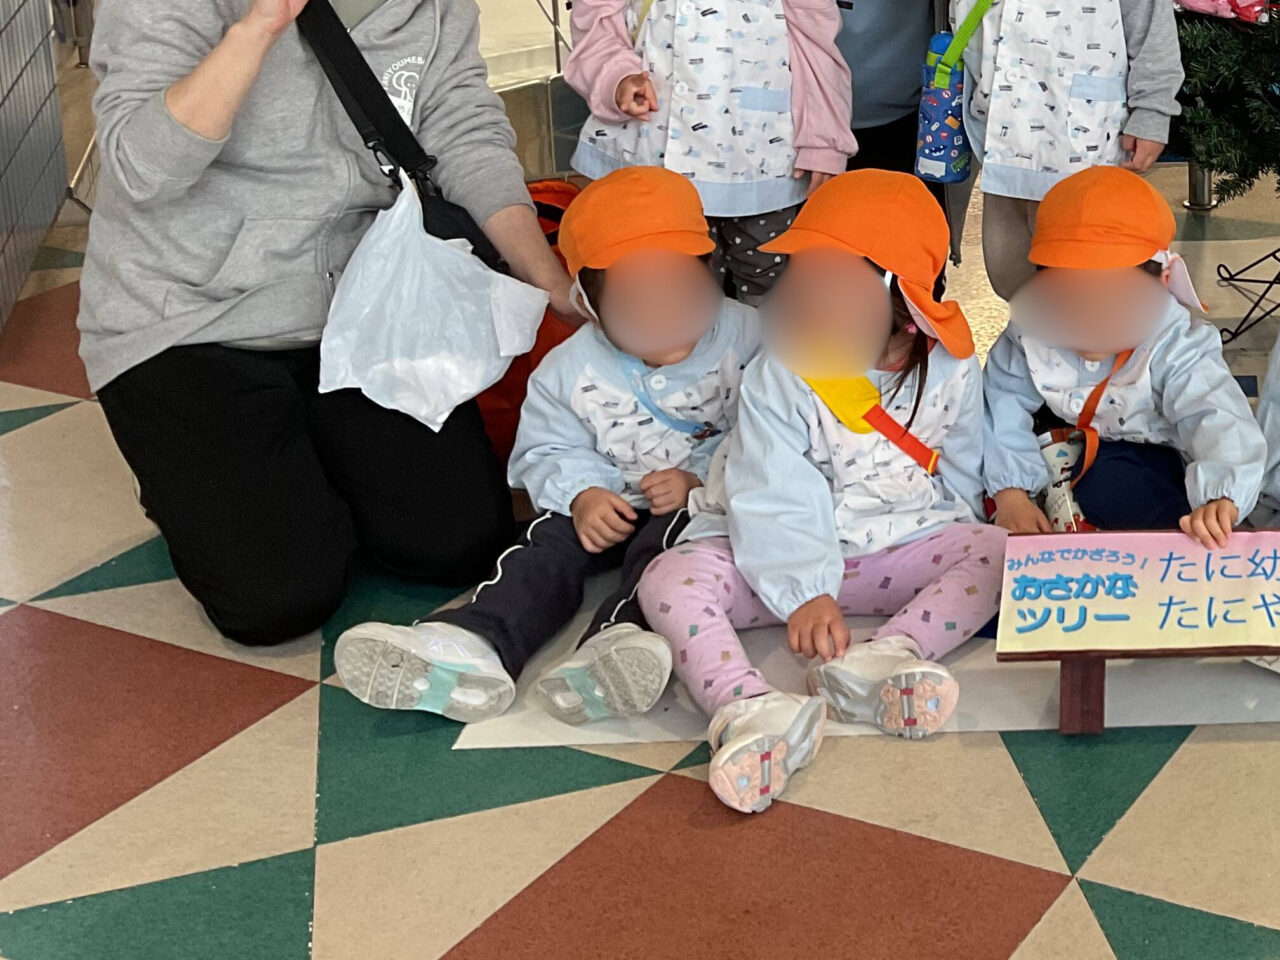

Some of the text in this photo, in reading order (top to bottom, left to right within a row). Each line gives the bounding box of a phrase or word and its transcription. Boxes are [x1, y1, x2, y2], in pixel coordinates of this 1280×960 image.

[1011, 572, 1139, 601] おさかな
[1015, 605, 1130, 634] ツリー
